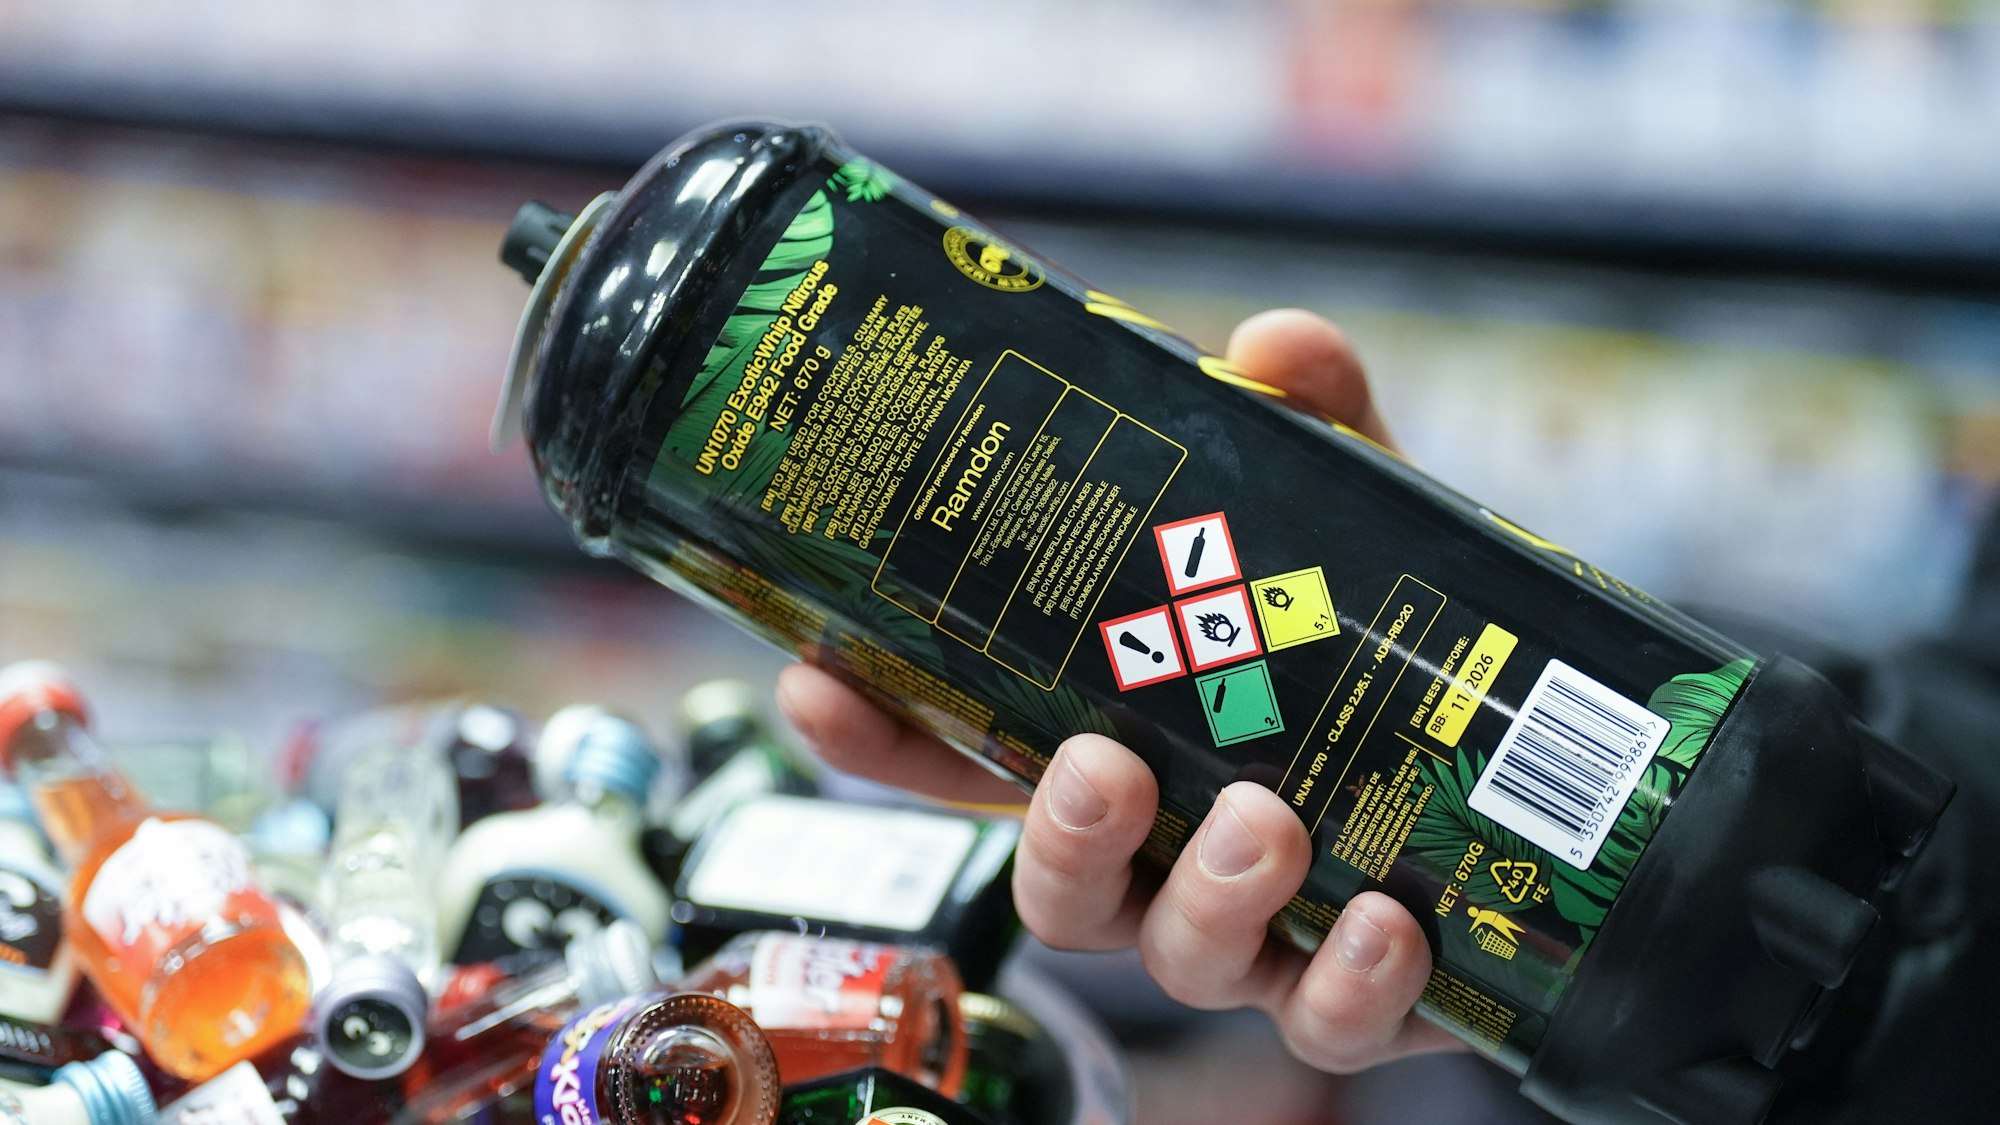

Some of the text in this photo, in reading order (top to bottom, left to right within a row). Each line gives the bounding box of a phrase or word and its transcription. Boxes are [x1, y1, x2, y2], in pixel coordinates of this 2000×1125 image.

[695, 259, 829, 474] UN1070 ExoticWhip Nitrous
[721, 283, 838, 470] Oxide E942 Food Grade
[769, 344, 832, 432] NET: 670 g
[917, 334, 946, 370] PLATOS
[935, 355, 960, 385] PIATTI
[760, 293, 889, 512] [EN] TO BE USED FOR COCKTAILS, CULINARY
[776, 314, 890, 501] DISHES, CAKES AND WHIPPED CREAM.
[779, 304, 911, 525] [FR] UTILISER POUR LES COCKTAILS, LES PLATS
[801, 510, 819, 534] [DE]
[821, 436, 858, 491] COCKTAILS,
[850, 364, 899, 436] KULINARISCHE
[892, 320, 930, 367] GERICHTE,
[824, 351, 919, 505] TORTEN UND ZUM SCHLAGSAHNE
[837, 348, 950, 534] CULINARIOS, PASTELES, CREMA BATIDA
[876, 420, 892, 437] EN
[893, 431, 912, 455] PER
[906, 385, 943, 433] COCKTAIL,
[786, 478, 821, 534] CULINAIRES,
[813, 456, 830, 478] LES
[850, 394, 864, 412] ET
[858, 383, 873, 398] LA
[846, 471, 864, 494] SER
[857, 435, 883, 472] USADO
[858, 359, 973, 549] GASTRONOMICI, TORTE PANNA MONTATA
[863, 452, 900, 509] UTILIZZARE
[913, 403, 986, 521] Officially produced by Ramdon
[930, 421, 1011, 532] Ramdon
[970, 451, 1016, 521] www.ramdon.com
[1010, 485, 1030, 512] Central
[1023, 457, 1047, 489] Business
[1040, 436, 1062, 460] District,
[1019, 482, 1046, 516] CBD1040,
[1039, 463, 1056, 483] Malta
[823, 517, 842, 540] [ES]
[832, 493, 853, 520] PARA
[856, 508, 871, 524] DA
[971, 433, 1051, 560] Ramdon Ltd. Quad Central Q3, Level 15,
[1016, 529, 1030, 542] Tel:
[1026, 510, 1040, 530] +356
[1023, 480, 1070, 552] Web: exotic-whip.com
[1024, 481, 1094, 594] [EN] NON-REFILLABLE CYLINDER
[1032, 479, 1109, 608] [FR] CYLINDER NON RECHARGEABLE
[1041, 598, 1057, 616] [DE]
[1049, 575, 1067, 601] NICHT
[1094, 484, 1122, 521] ZYLINDER
[1058, 500, 1127, 612] [ES] CILINDRO NO RECARGABLE
[1074, 571, 1101, 609] BOMBOLA
[1094, 553, 1110, 573] NON
[1314, 614, 1329, 630] 5.1
[1264, 717, 1275, 726] 2
[1308, 751, 1328, 777] 1070
[1327, 703, 1355, 743] CLASS
[1348, 671, 1374, 707] 2.2/5.1
[1410, 636, 1470, 728] [EN] BEST BEFORE:
[1430, 653, 1494, 734] BB: 11/2026
[1330, 770, 1381, 858] [FR] CONSOMMER DE
[1348, 746, 1420, 868] [DE] MINDESTENS HALTBAR BIS:
[1357, 766, 1421, 873] [ES] CONSÚMASE ANTES DE:
[1365, 782, 1387, 814] AVANT:
[1372, 853, 1385, 866] DA
[1379, 801, 1413, 854] CONSUMARSI
[1375, 783, 1435, 883] PREFERIBILMENTE ENTRO:
[1570, 731, 1651, 860] 5 350742 999861
[1435, 842, 1485, 917] NET: 670G
[1507, 869, 1524, 889] 40
[1532, 884, 1550, 904] FE
